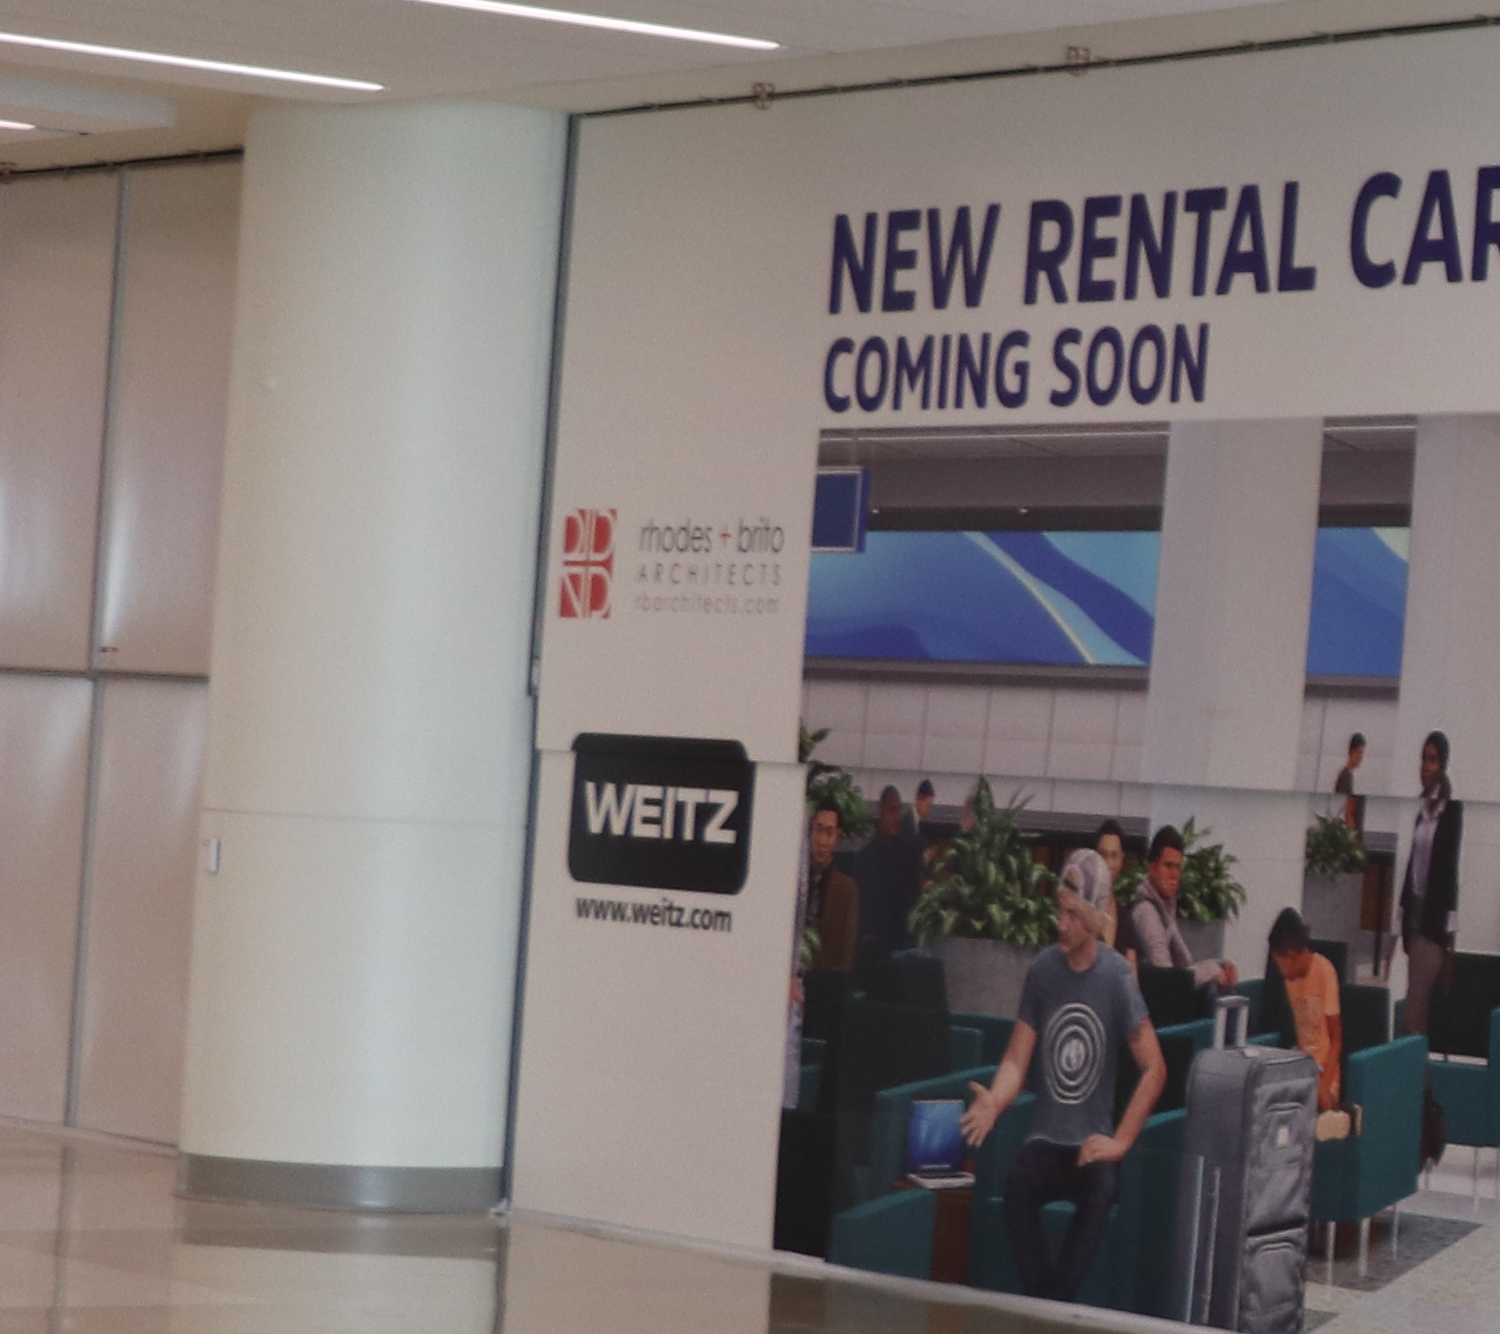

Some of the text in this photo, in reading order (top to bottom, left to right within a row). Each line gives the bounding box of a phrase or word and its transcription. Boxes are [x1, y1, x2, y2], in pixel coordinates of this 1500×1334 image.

[828, 203, 1000, 315] NEW
[1023, 180, 1317, 307] RENTAL
[823, 323, 1210, 413] COMING SOON
[639, 517, 712, 553] rhodes
[738, 517, 785, 554] brito
[638, 562, 782, 585] ARCHITECTS
[584, 781, 739, 844] WEITZ
[576, 897, 732, 932] www.weitz.com
